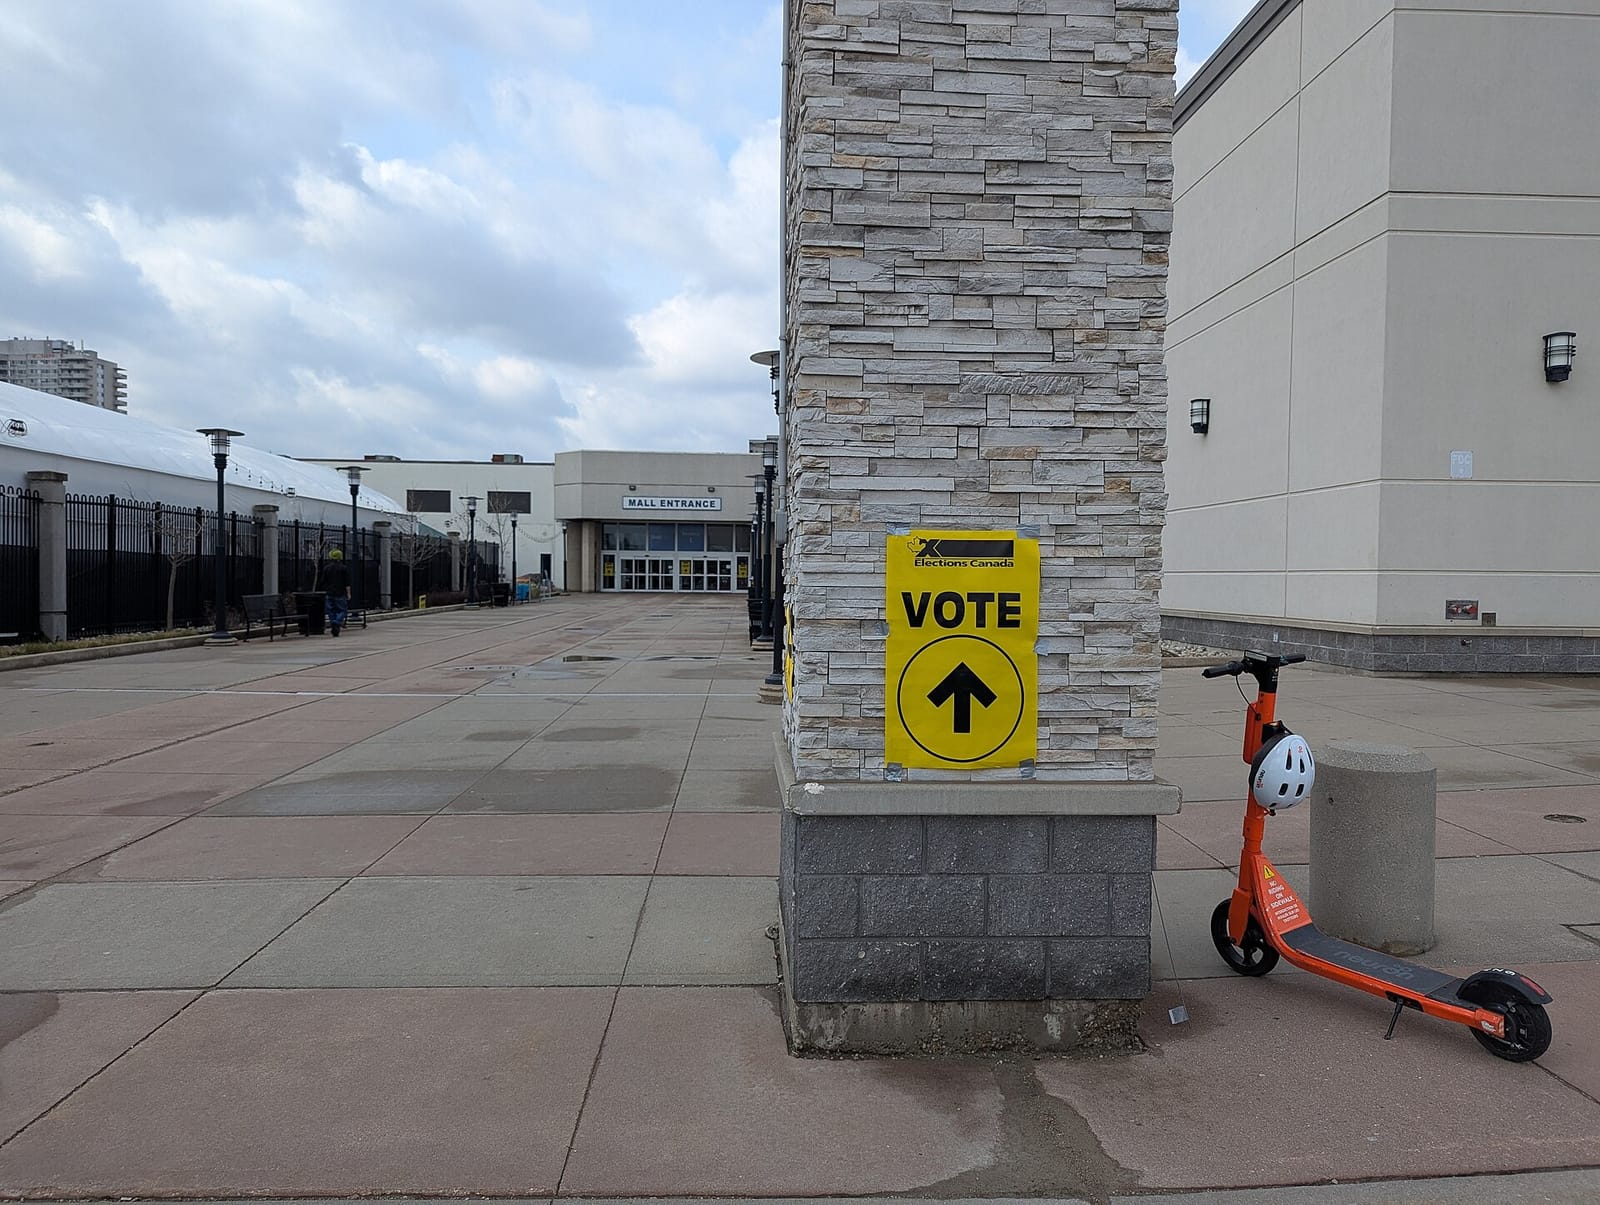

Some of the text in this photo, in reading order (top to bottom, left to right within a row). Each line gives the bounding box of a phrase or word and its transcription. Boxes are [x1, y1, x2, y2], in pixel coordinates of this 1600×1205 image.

[628, 498, 716, 508] MALL ENTRANCE
[914, 558, 1014, 568] Elections Canada
[901, 591, 1021, 629] VOTE
[1270, 895, 1295, 909] SIDEWALK
[1333, 950, 1415, 980] neuron
